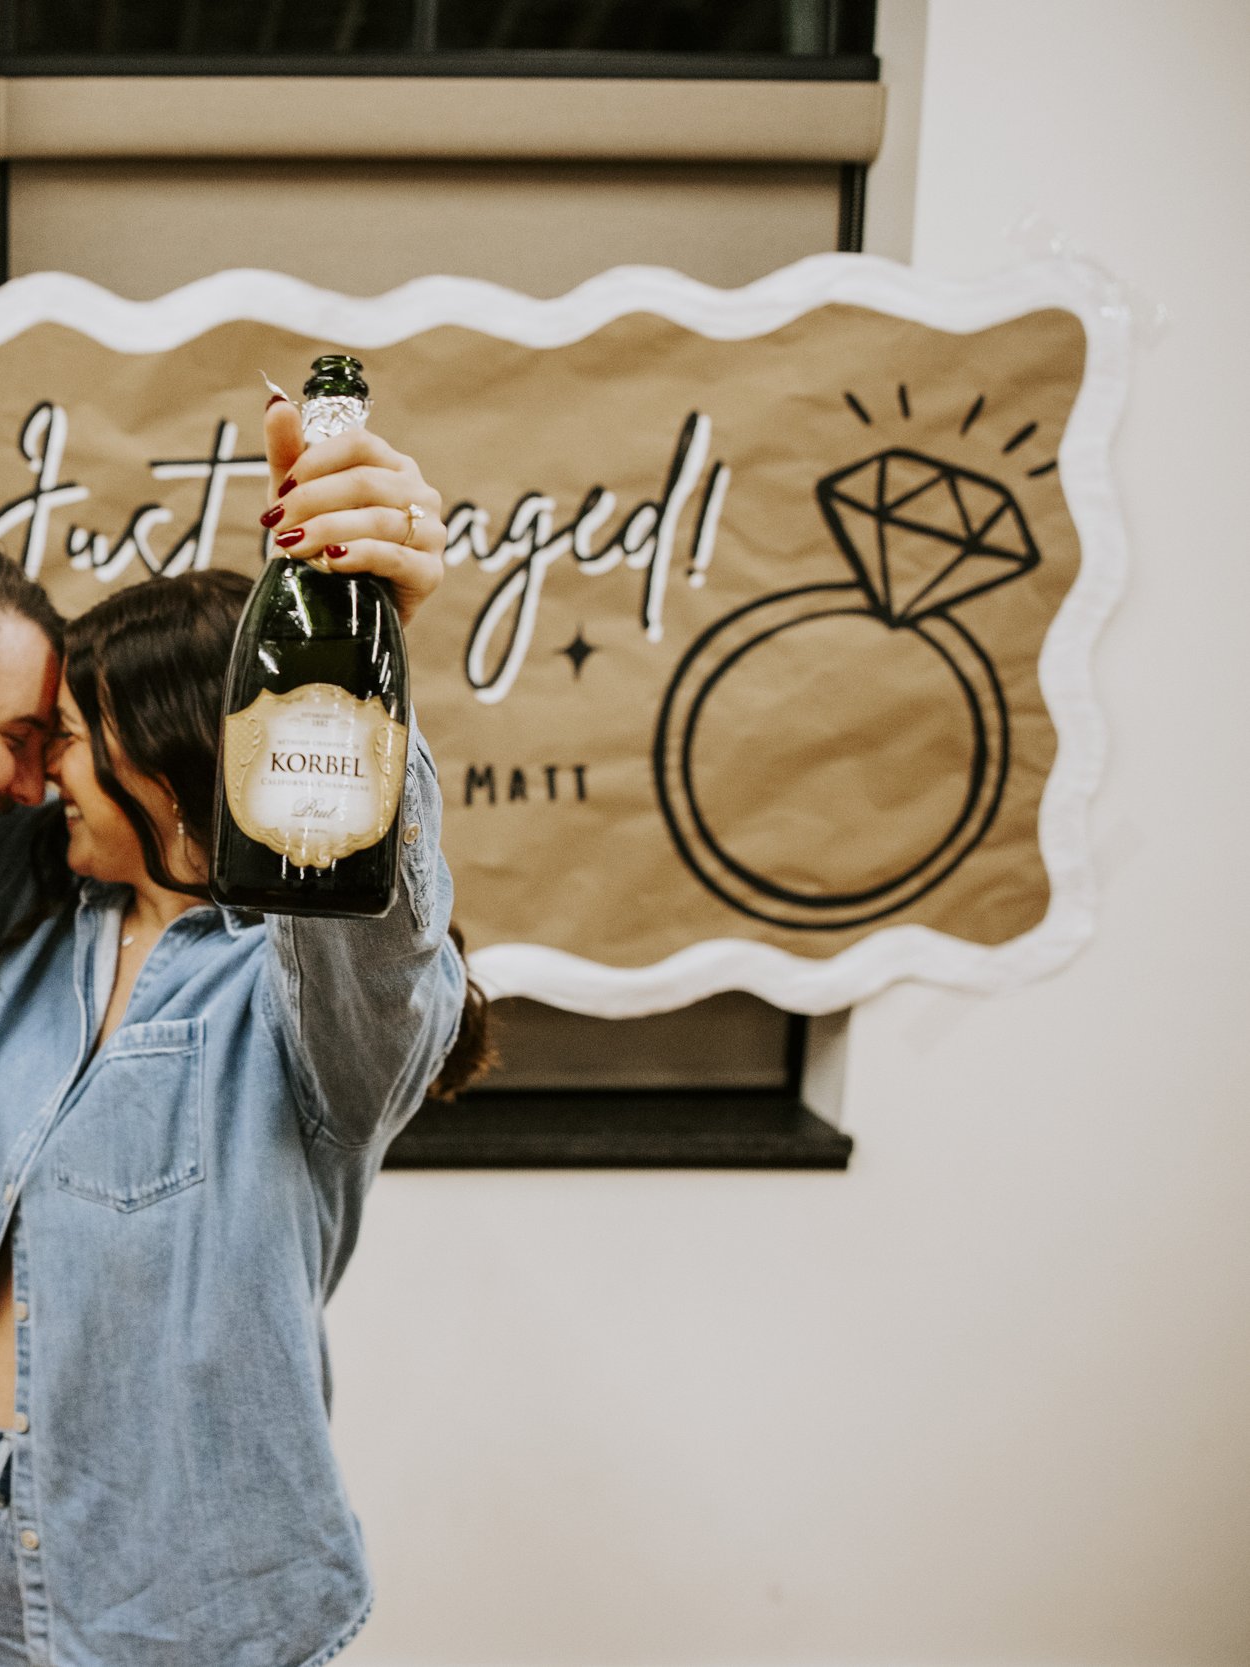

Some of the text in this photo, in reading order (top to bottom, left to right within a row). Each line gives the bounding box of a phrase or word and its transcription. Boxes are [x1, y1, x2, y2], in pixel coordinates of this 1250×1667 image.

[263, 411, 731, 704] aged!
[270, 752, 365, 778] KORBEL
[463, 763, 588, 806] MATT
[291, 796, 338, 819] Brut
